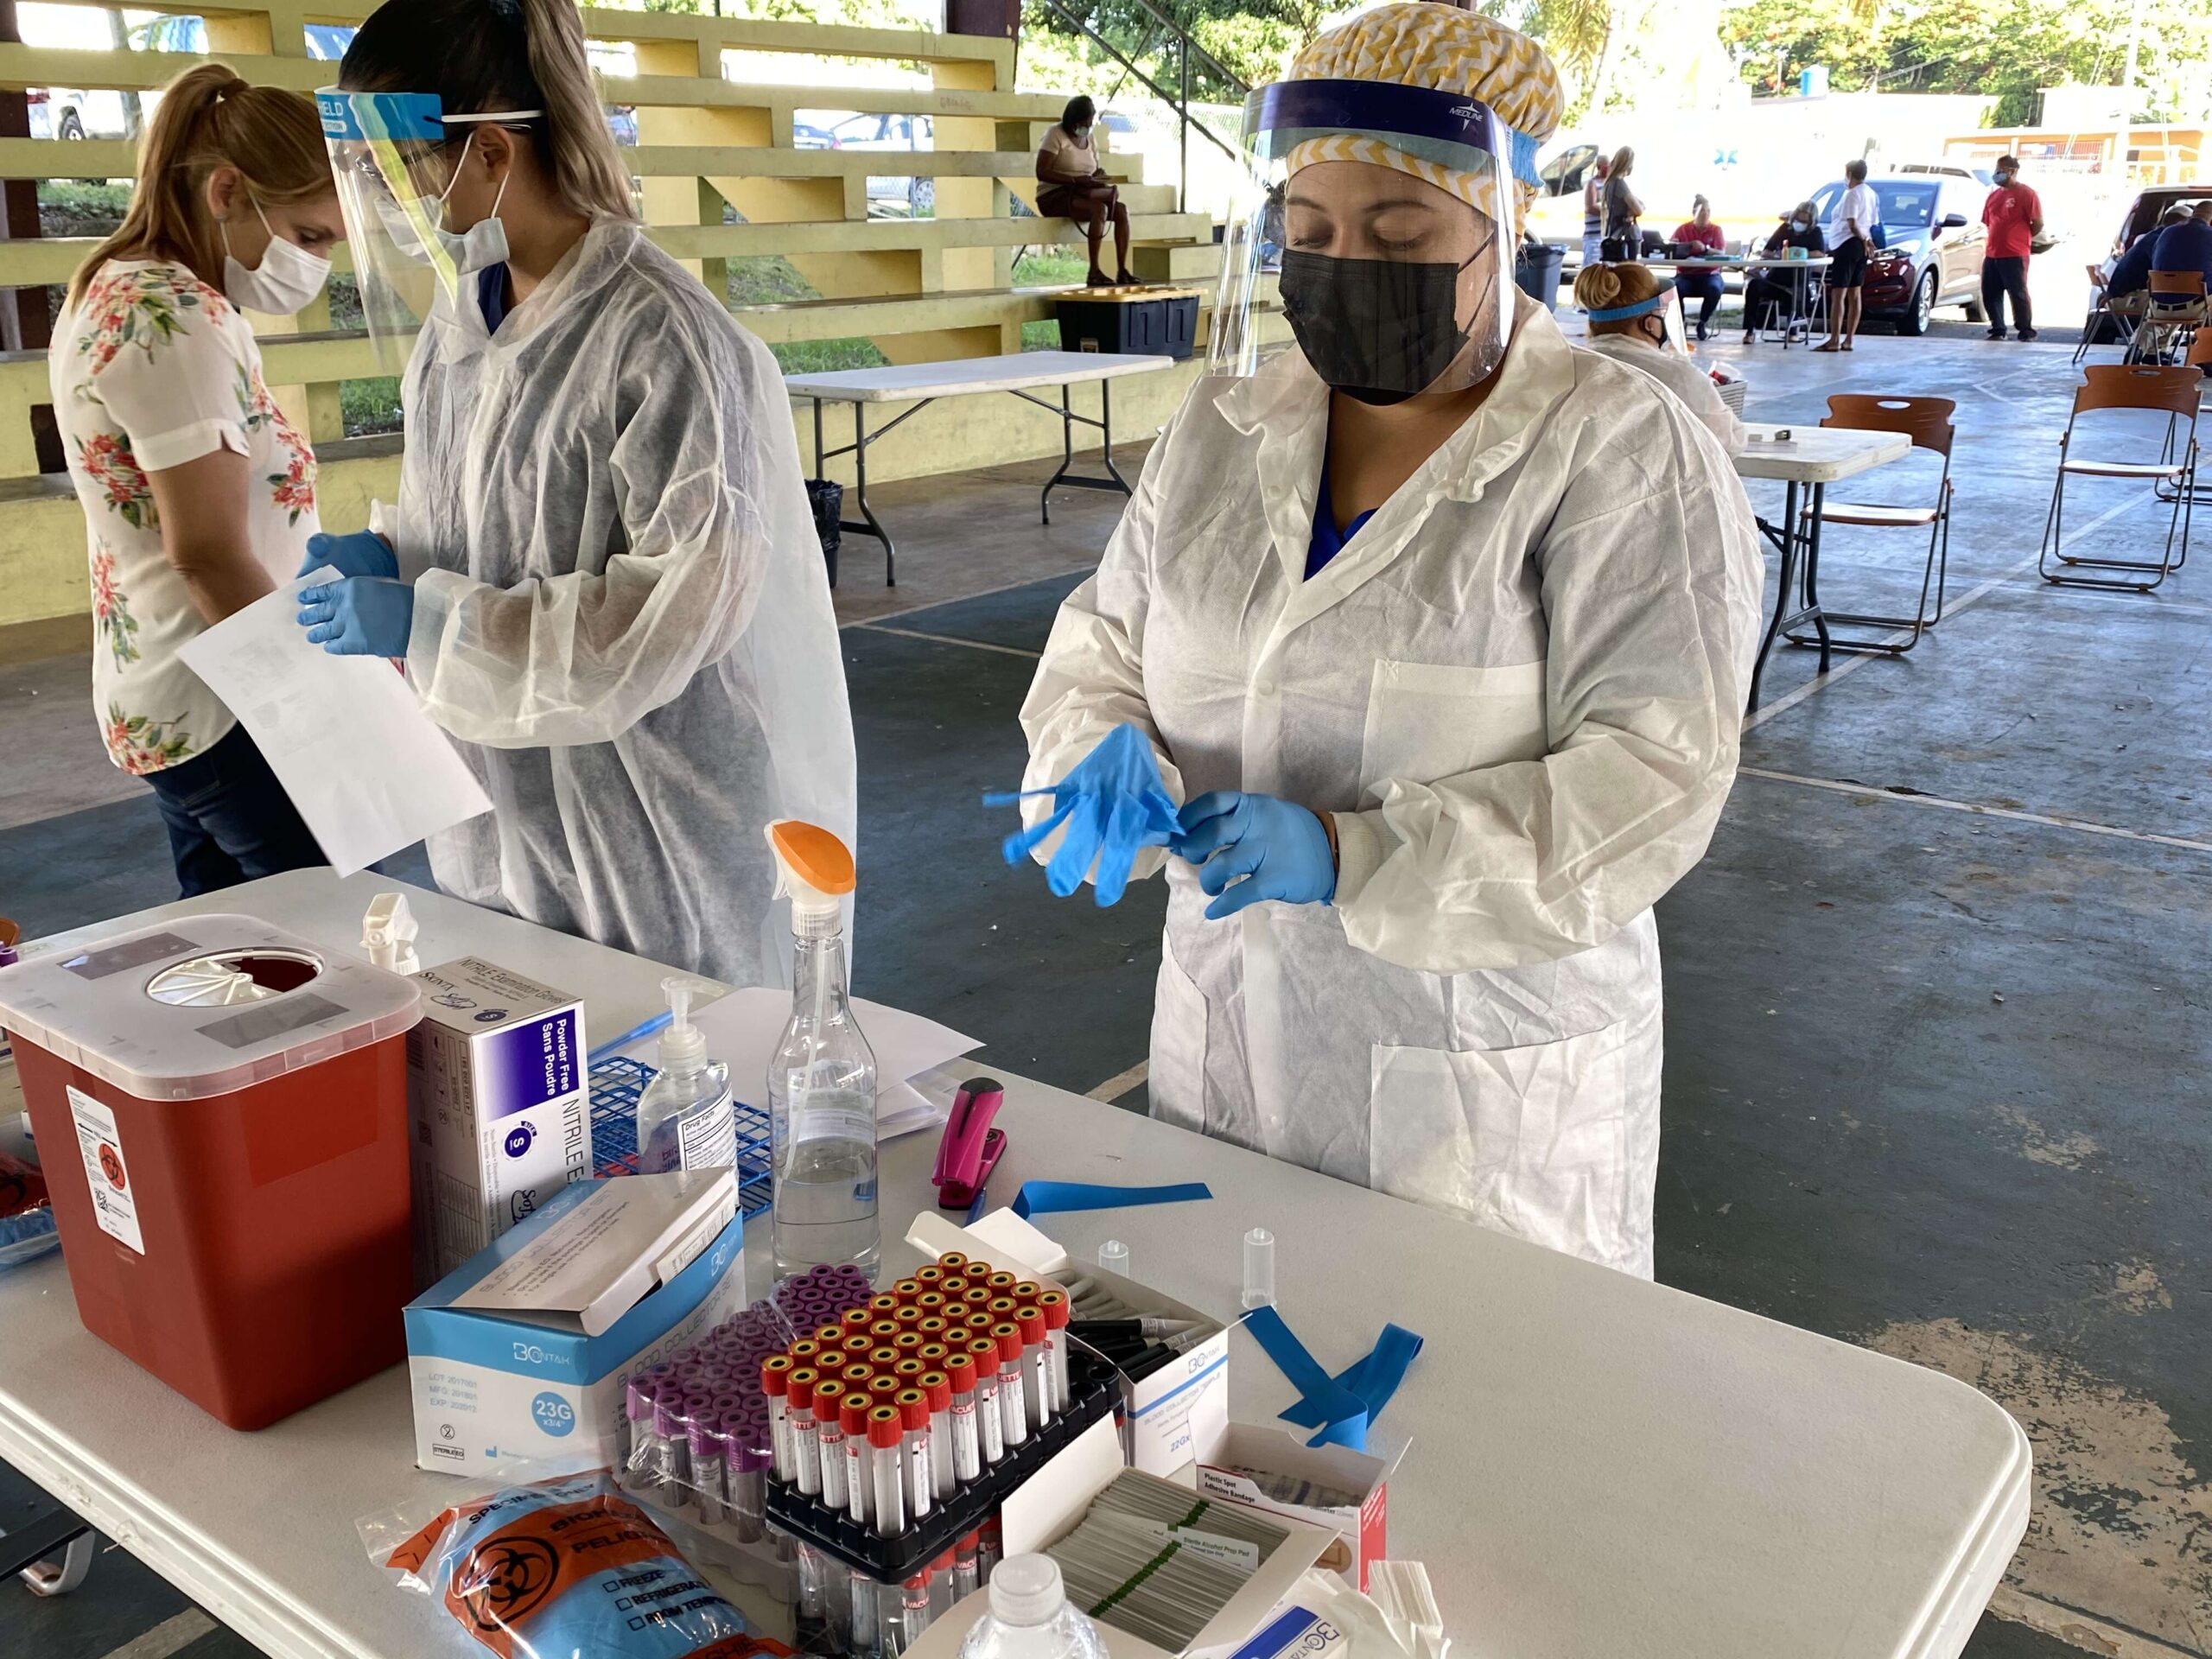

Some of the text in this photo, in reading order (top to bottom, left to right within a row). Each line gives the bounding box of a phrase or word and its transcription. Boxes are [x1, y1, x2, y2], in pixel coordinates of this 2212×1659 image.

[1449, 107, 1484, 122] MEDLINE
[543, 1022, 557, 1096] Sans Poudre
[556, 1019, 569, 1091] Powder Free
[563, 1098, 583, 1166] NITRILE
[685, 1119, 701, 1131] Drug
[536, 1400, 572, 1421] 23G
[1204, 1472, 1236, 1489] Plastic Spot
[1204, 1482, 1255, 1503] Adhesive Bandage
[1201, 1541, 1224, 1551] Alcohol
[619, 1569, 665, 1588] FREEZE
